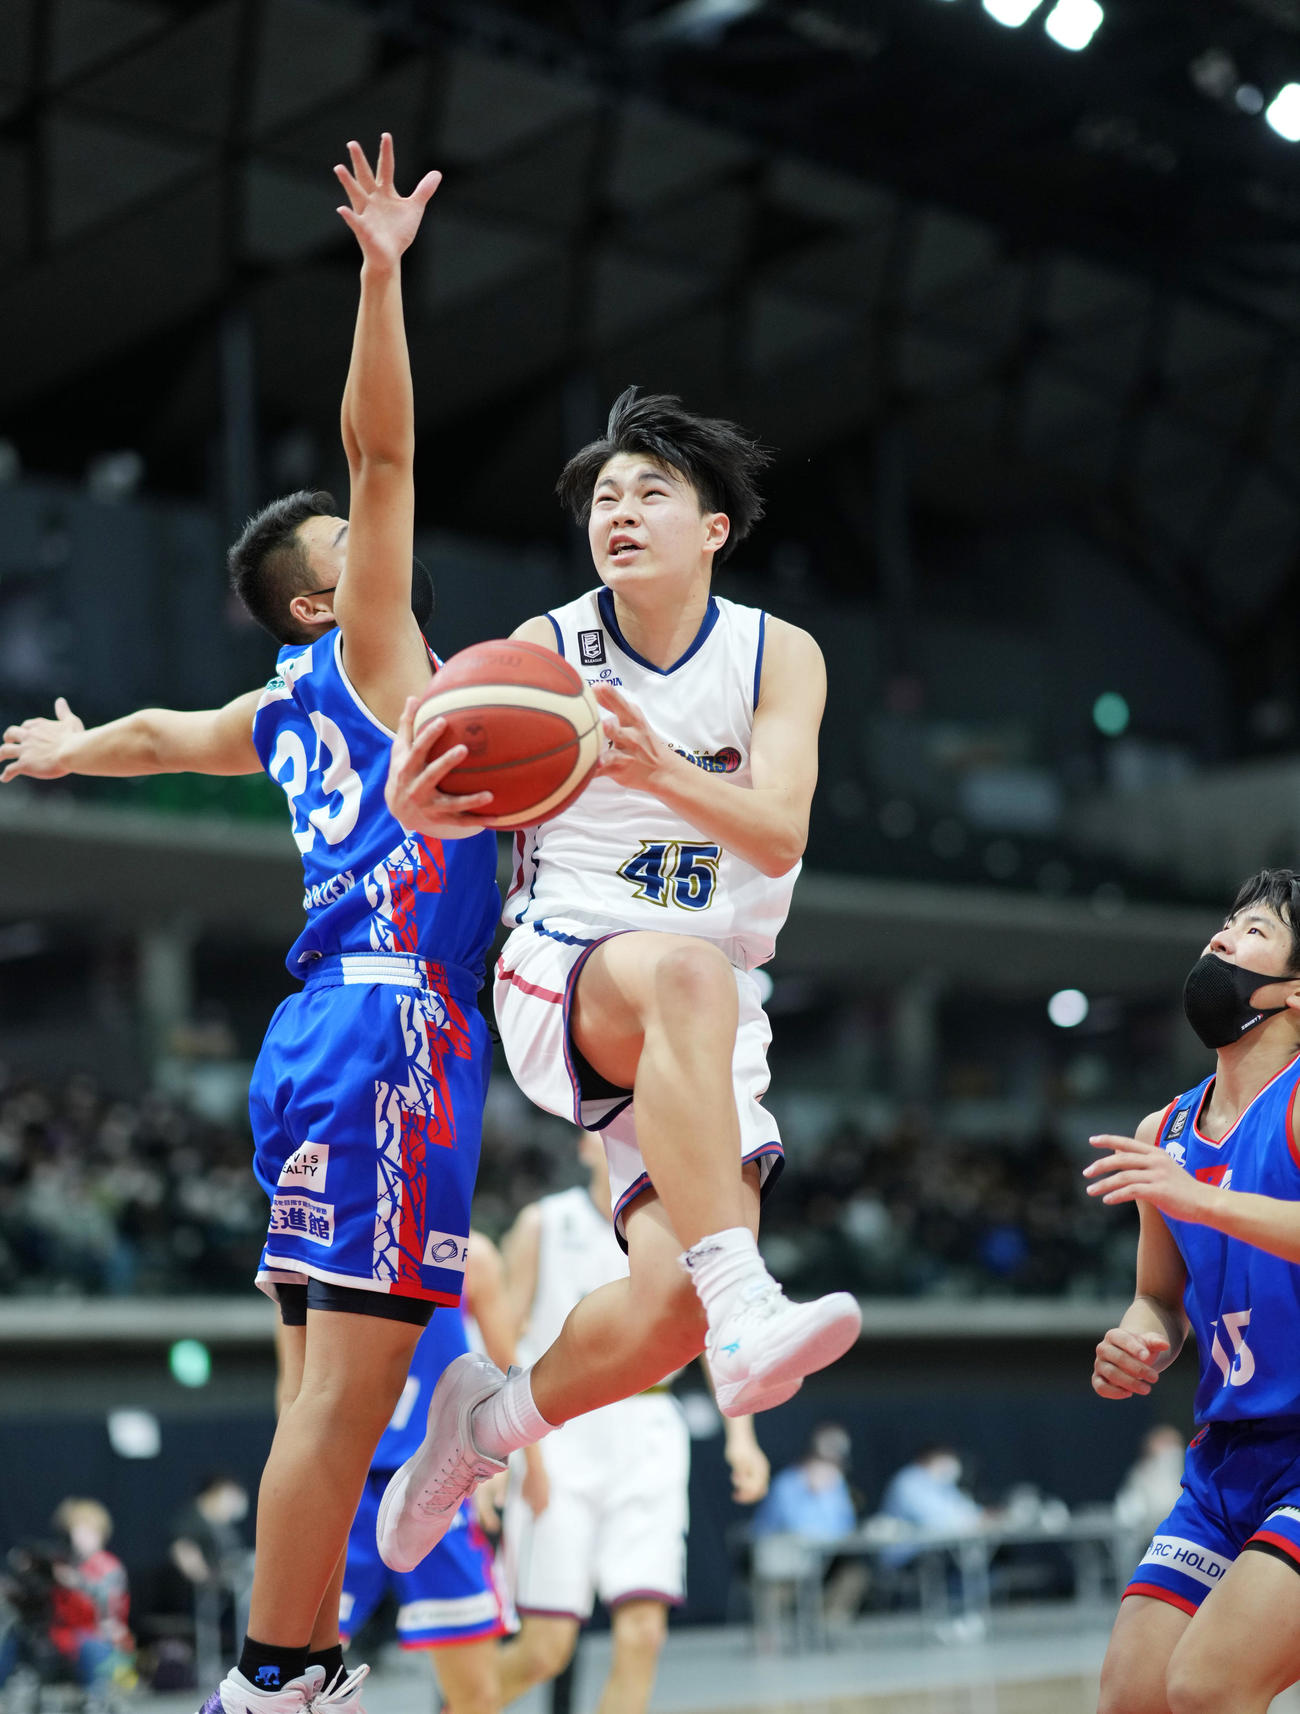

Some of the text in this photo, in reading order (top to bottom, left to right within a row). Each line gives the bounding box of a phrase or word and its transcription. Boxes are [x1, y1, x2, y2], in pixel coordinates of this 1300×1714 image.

[269, 711, 363, 857] 23
[616, 840, 723, 912] 45
[1210, 1308, 1255, 1388] 15
